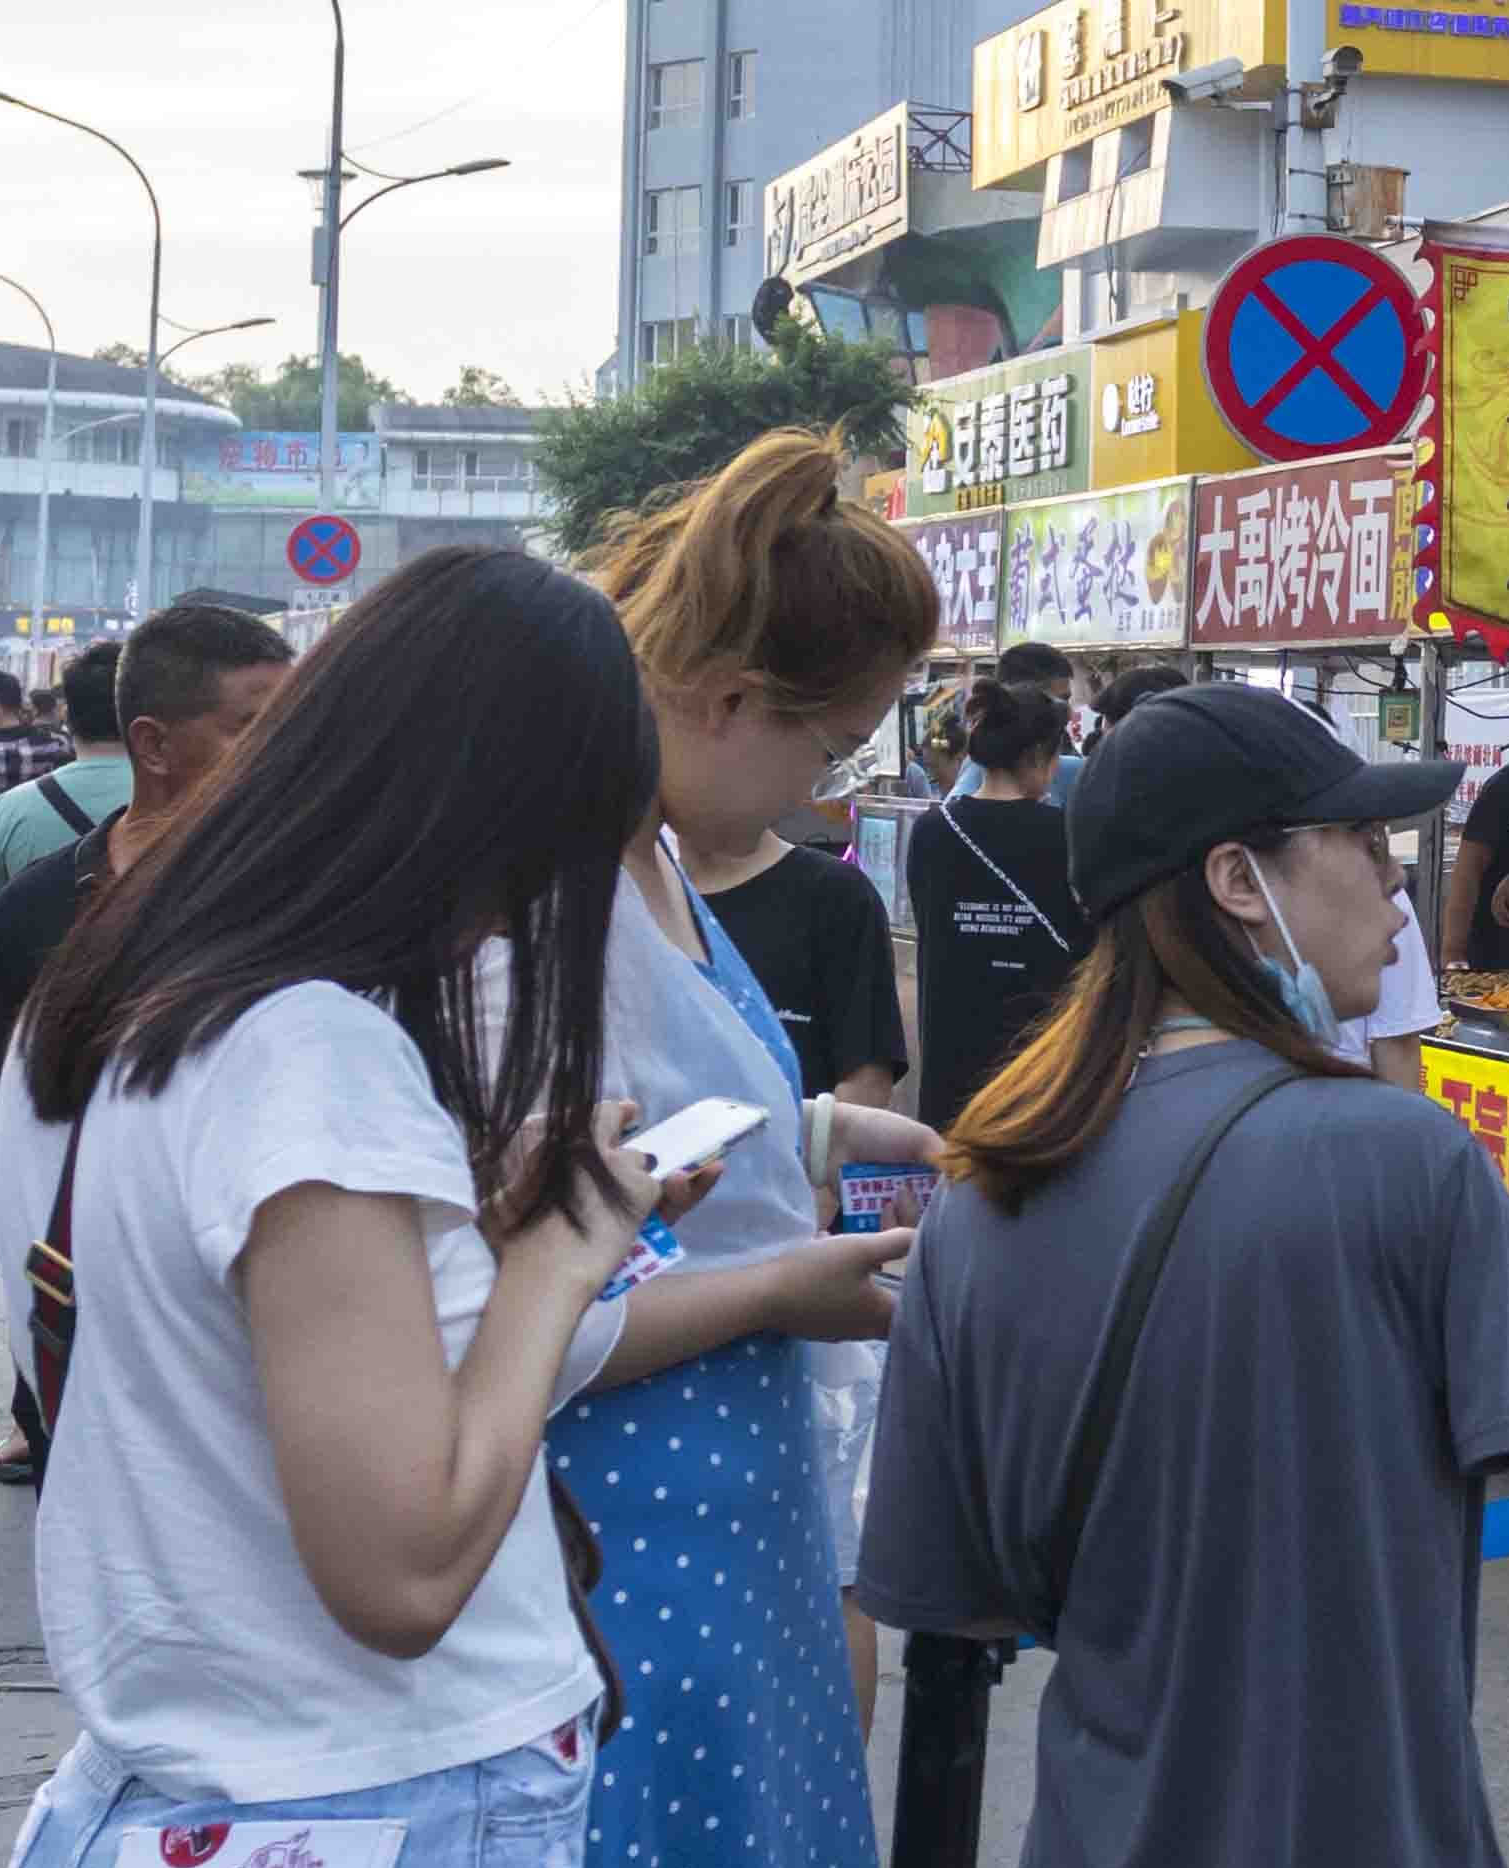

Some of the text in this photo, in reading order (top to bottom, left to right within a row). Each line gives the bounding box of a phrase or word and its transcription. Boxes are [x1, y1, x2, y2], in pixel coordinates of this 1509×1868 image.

[1195, 479, 1394, 631] 大禹烤冷面
